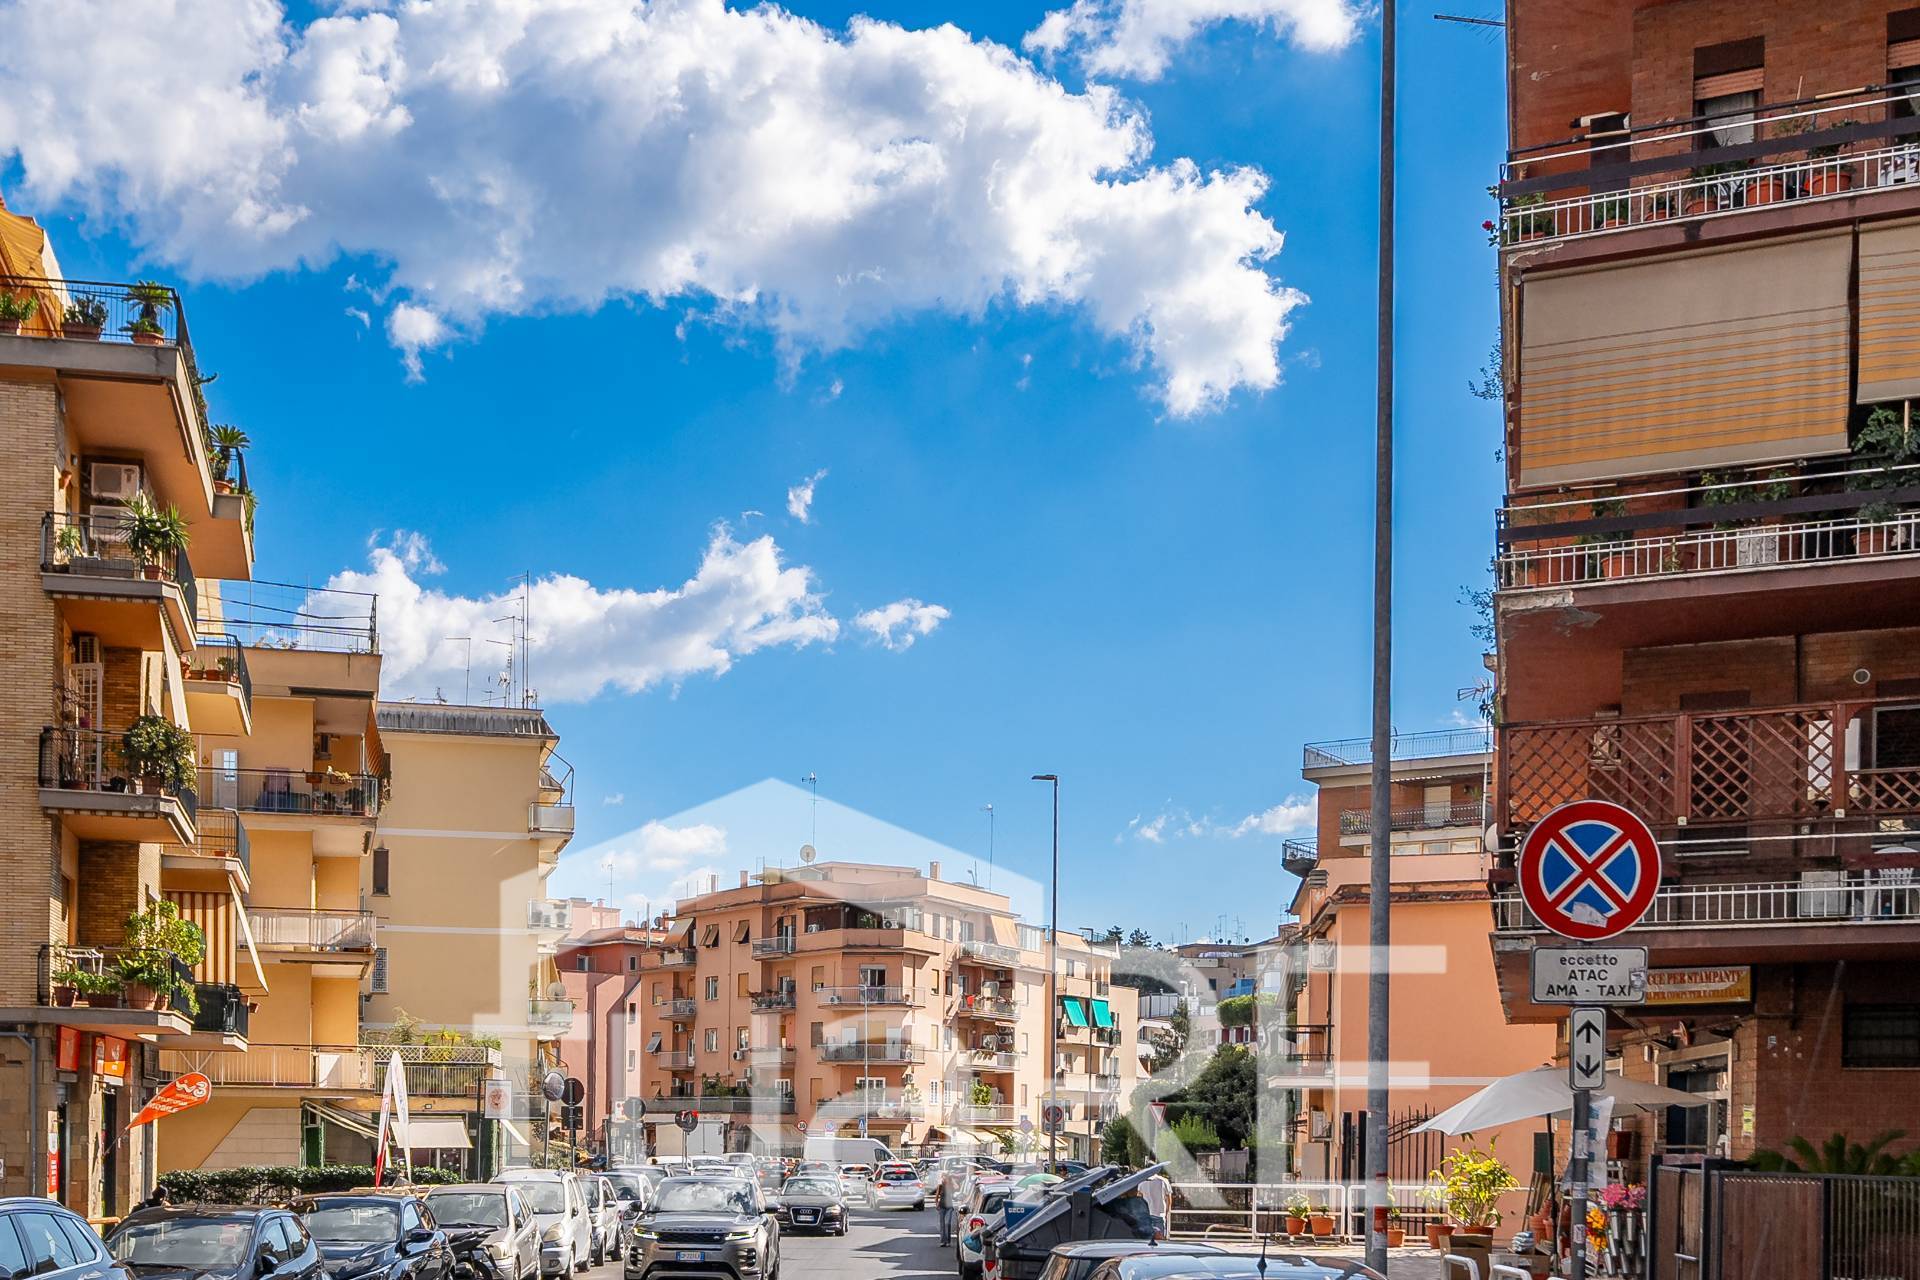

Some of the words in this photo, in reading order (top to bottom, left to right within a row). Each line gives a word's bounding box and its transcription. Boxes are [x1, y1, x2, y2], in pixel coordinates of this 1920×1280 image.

[1559, 954, 1618, 966] eccetto
[1567, 969, 1609, 981] ATAC
[1545, 984, 1578, 996] AMA
[1597, 984, 1632, 997] TAXI
